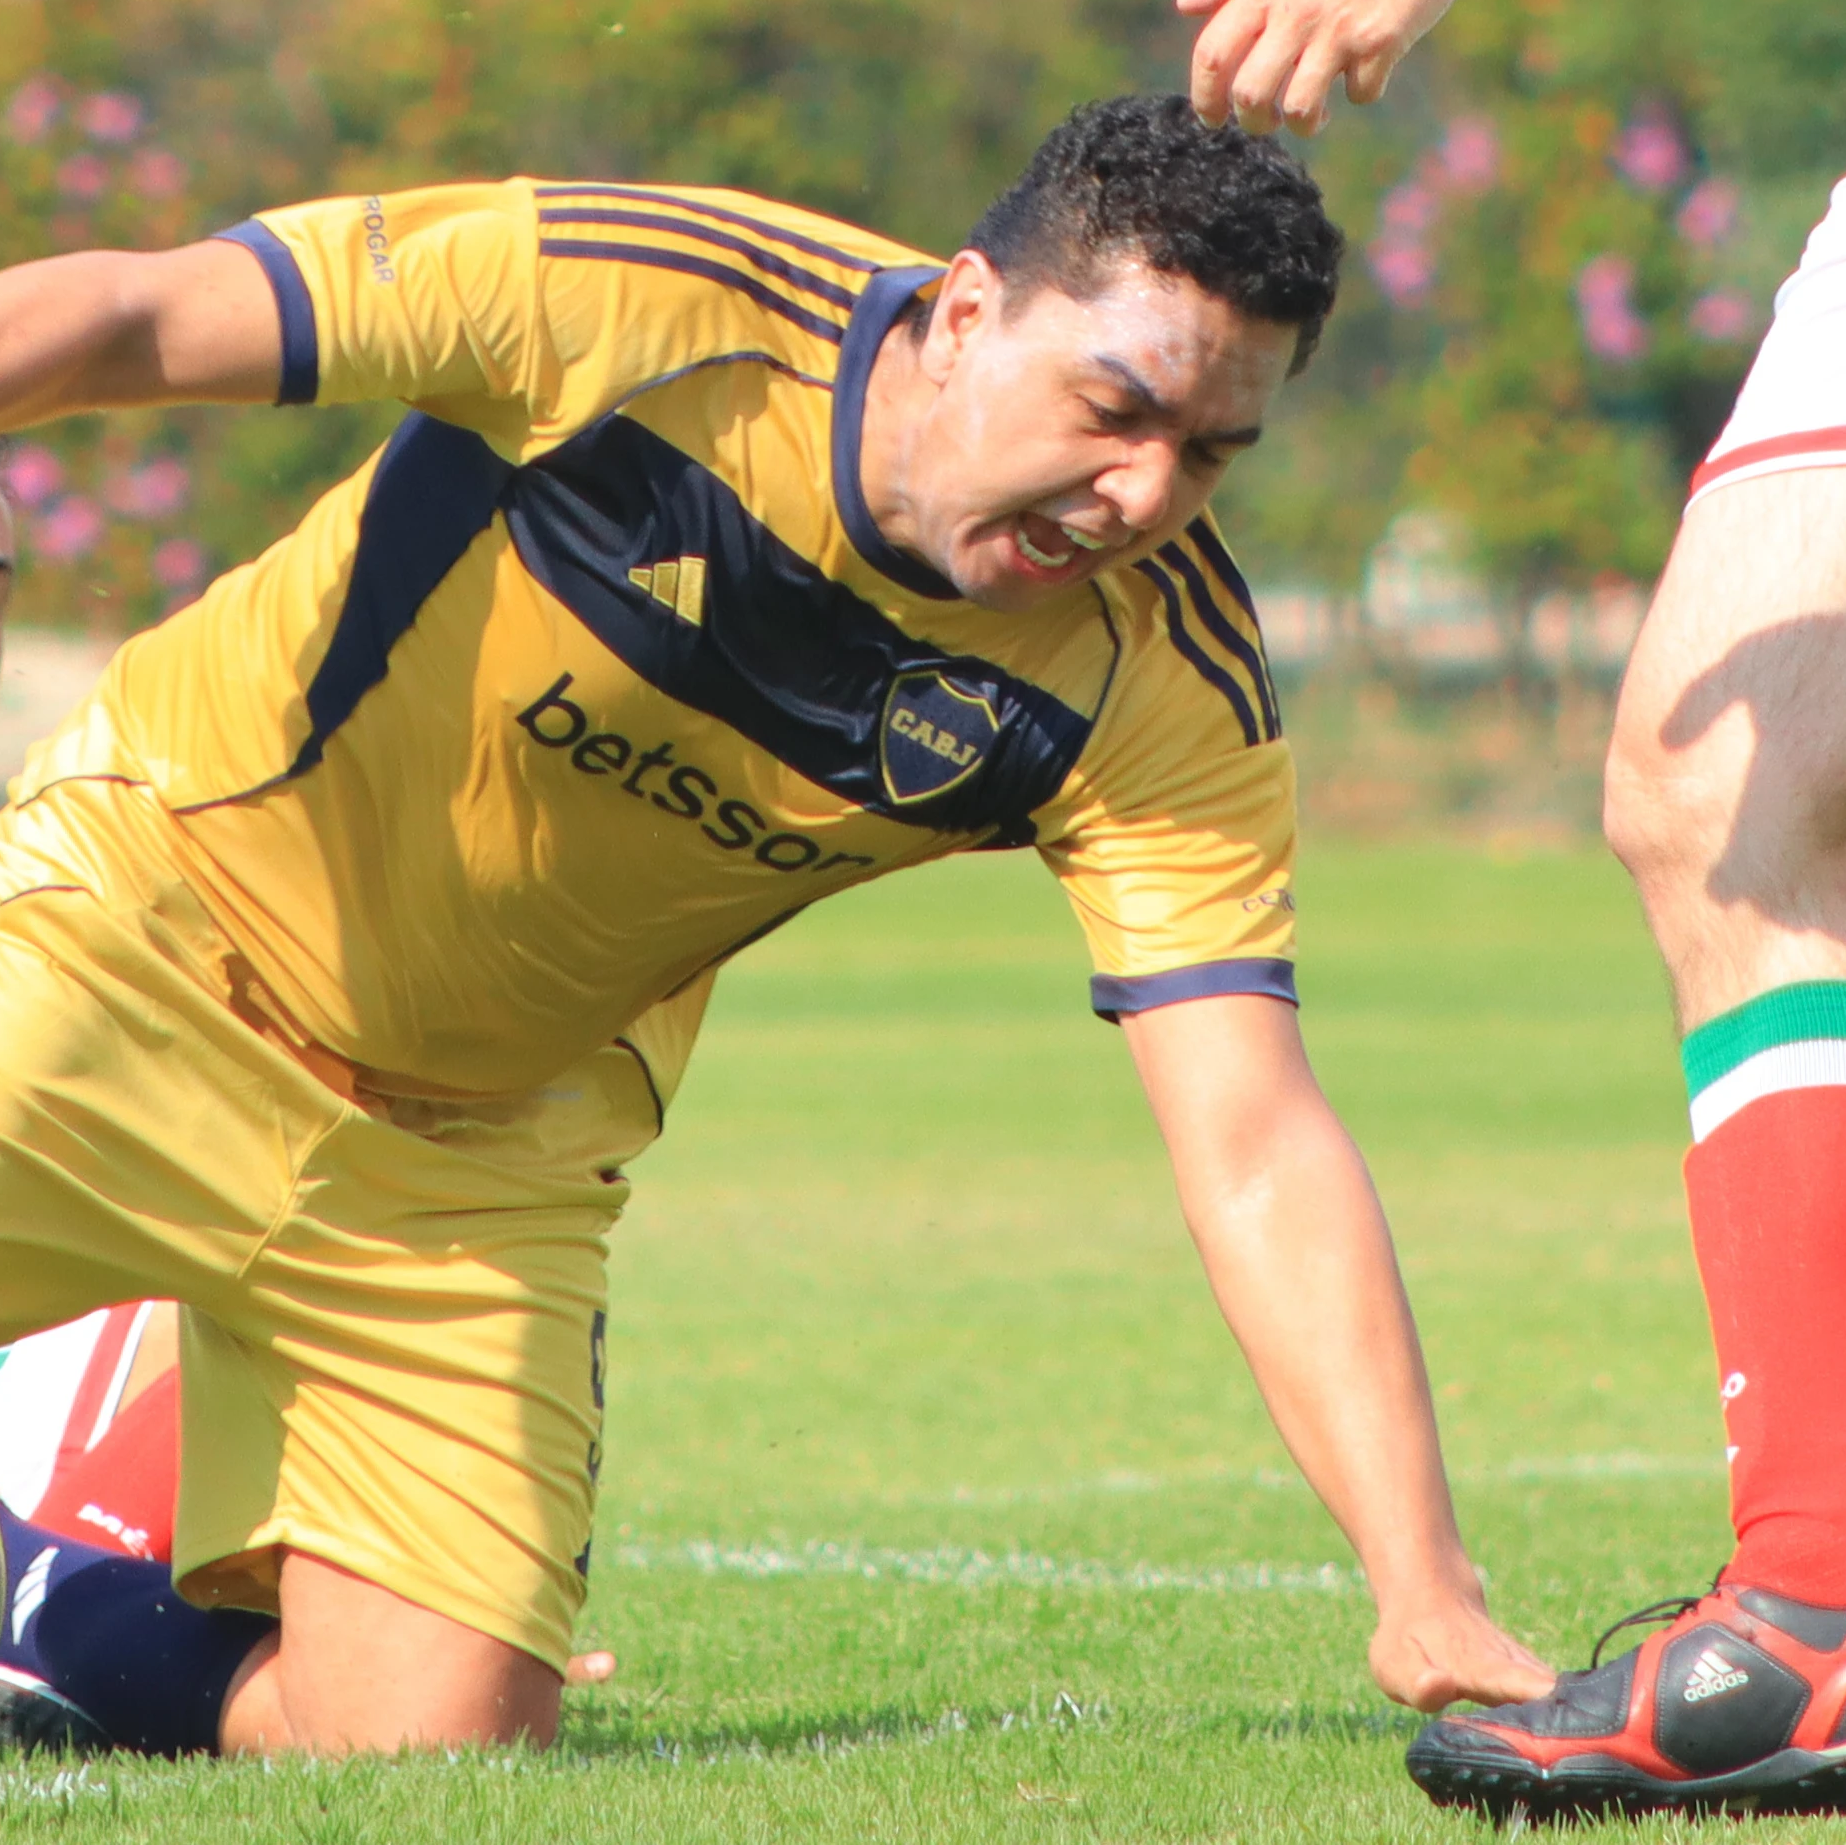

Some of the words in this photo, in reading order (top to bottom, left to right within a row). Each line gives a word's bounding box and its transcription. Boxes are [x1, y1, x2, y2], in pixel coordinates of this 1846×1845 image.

[361, 195, 396, 285] ROGAR
[890, 708, 977, 766] CABJ
[1683, 1668, 1749, 1702] adidas
